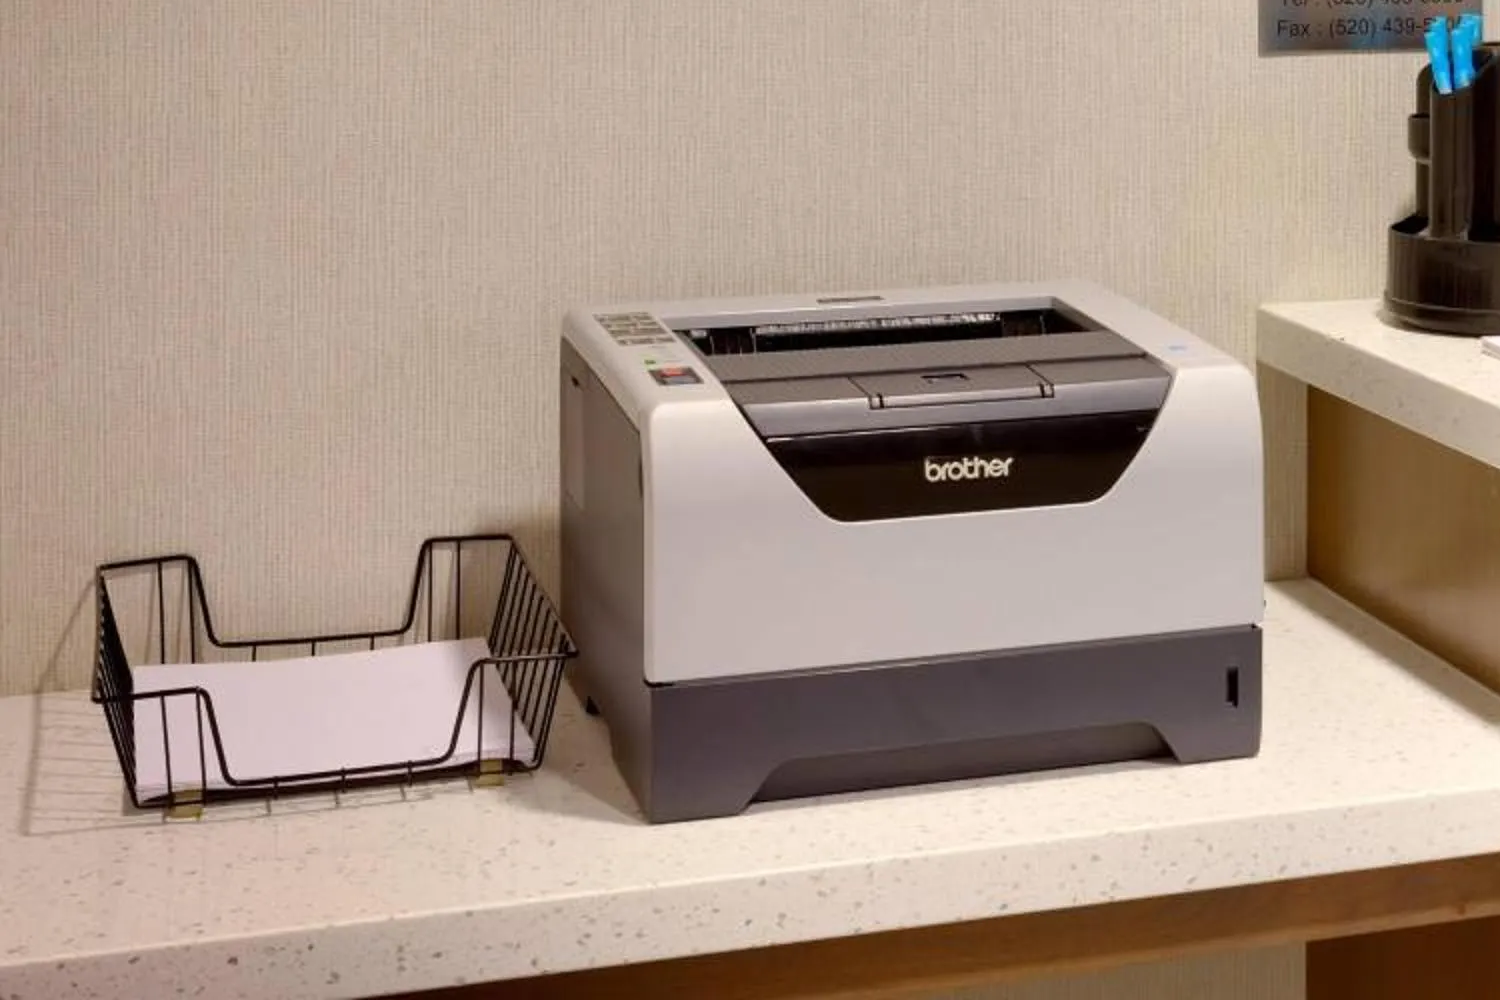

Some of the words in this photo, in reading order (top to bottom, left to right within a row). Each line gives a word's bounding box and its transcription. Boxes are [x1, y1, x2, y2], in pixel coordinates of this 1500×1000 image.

[1277, 20, 1311, 37] Fax
[1329, 18, 1376, 39] (520)
[924, 456, 1015, 482] brother
